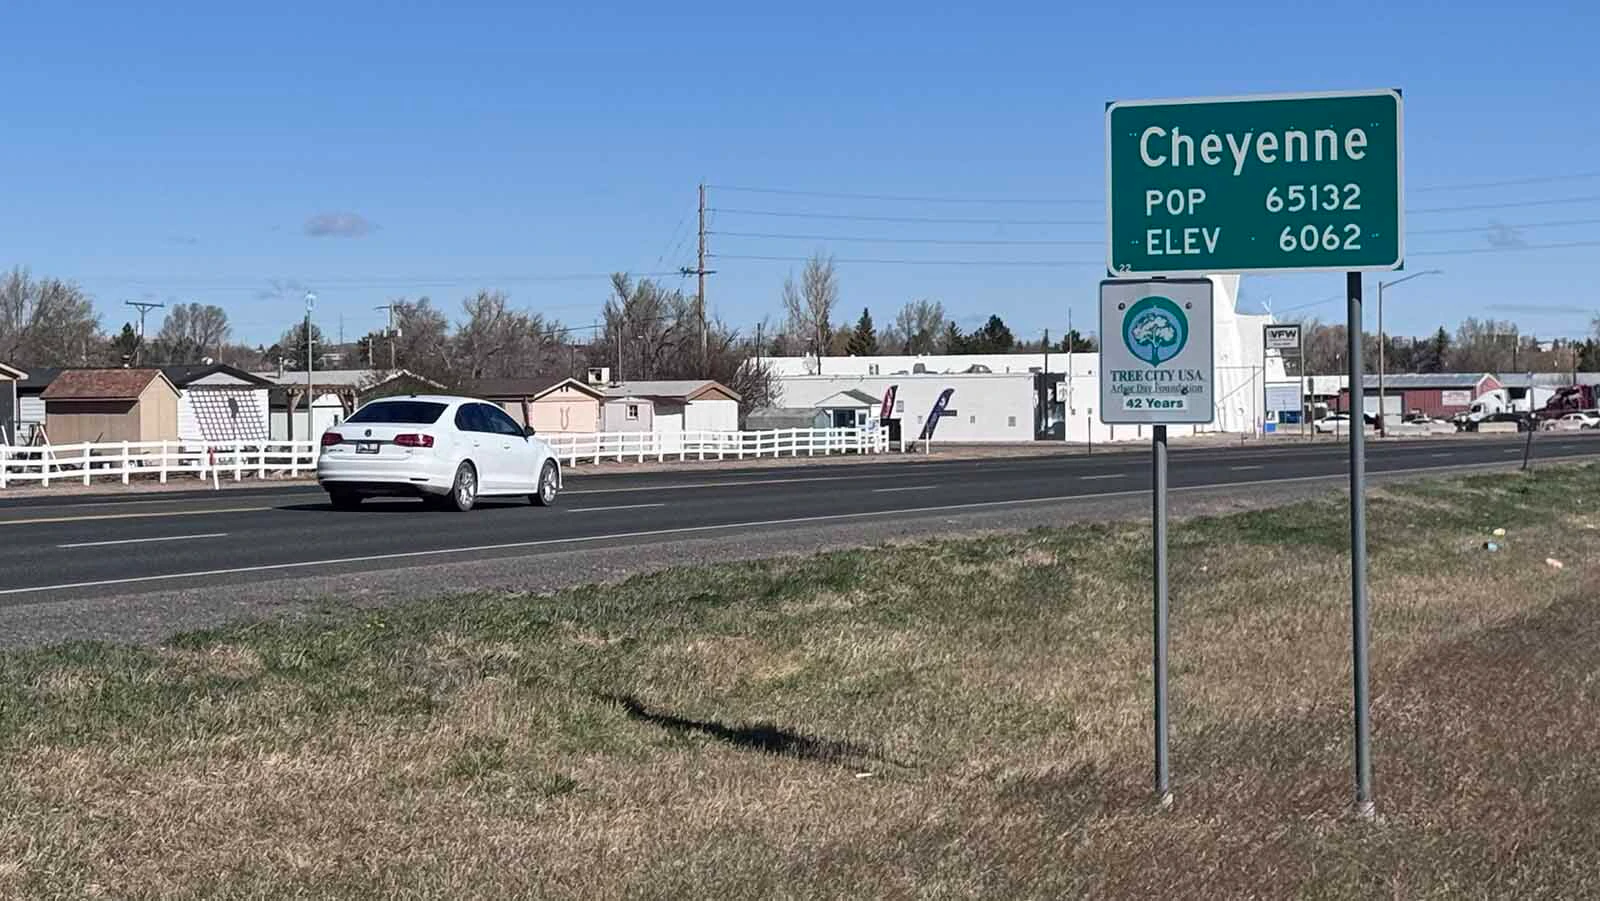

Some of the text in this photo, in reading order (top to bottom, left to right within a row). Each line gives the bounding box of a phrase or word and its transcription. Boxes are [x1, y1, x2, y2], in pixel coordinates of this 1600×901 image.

[1139, 126, 1368, 176] Cheyenne
[1145, 183, 1361, 216] POP 65132
[1146, 224, 1361, 255] ELEV 6062
[1119, 263, 1132, 273] 22
[1270, 329, 1297, 338] VFW
[1110, 369, 1203, 382] TREE CITY USA
[1136, 383, 1152, 394] Day
[1126, 398, 1184, 408] 42 Years
